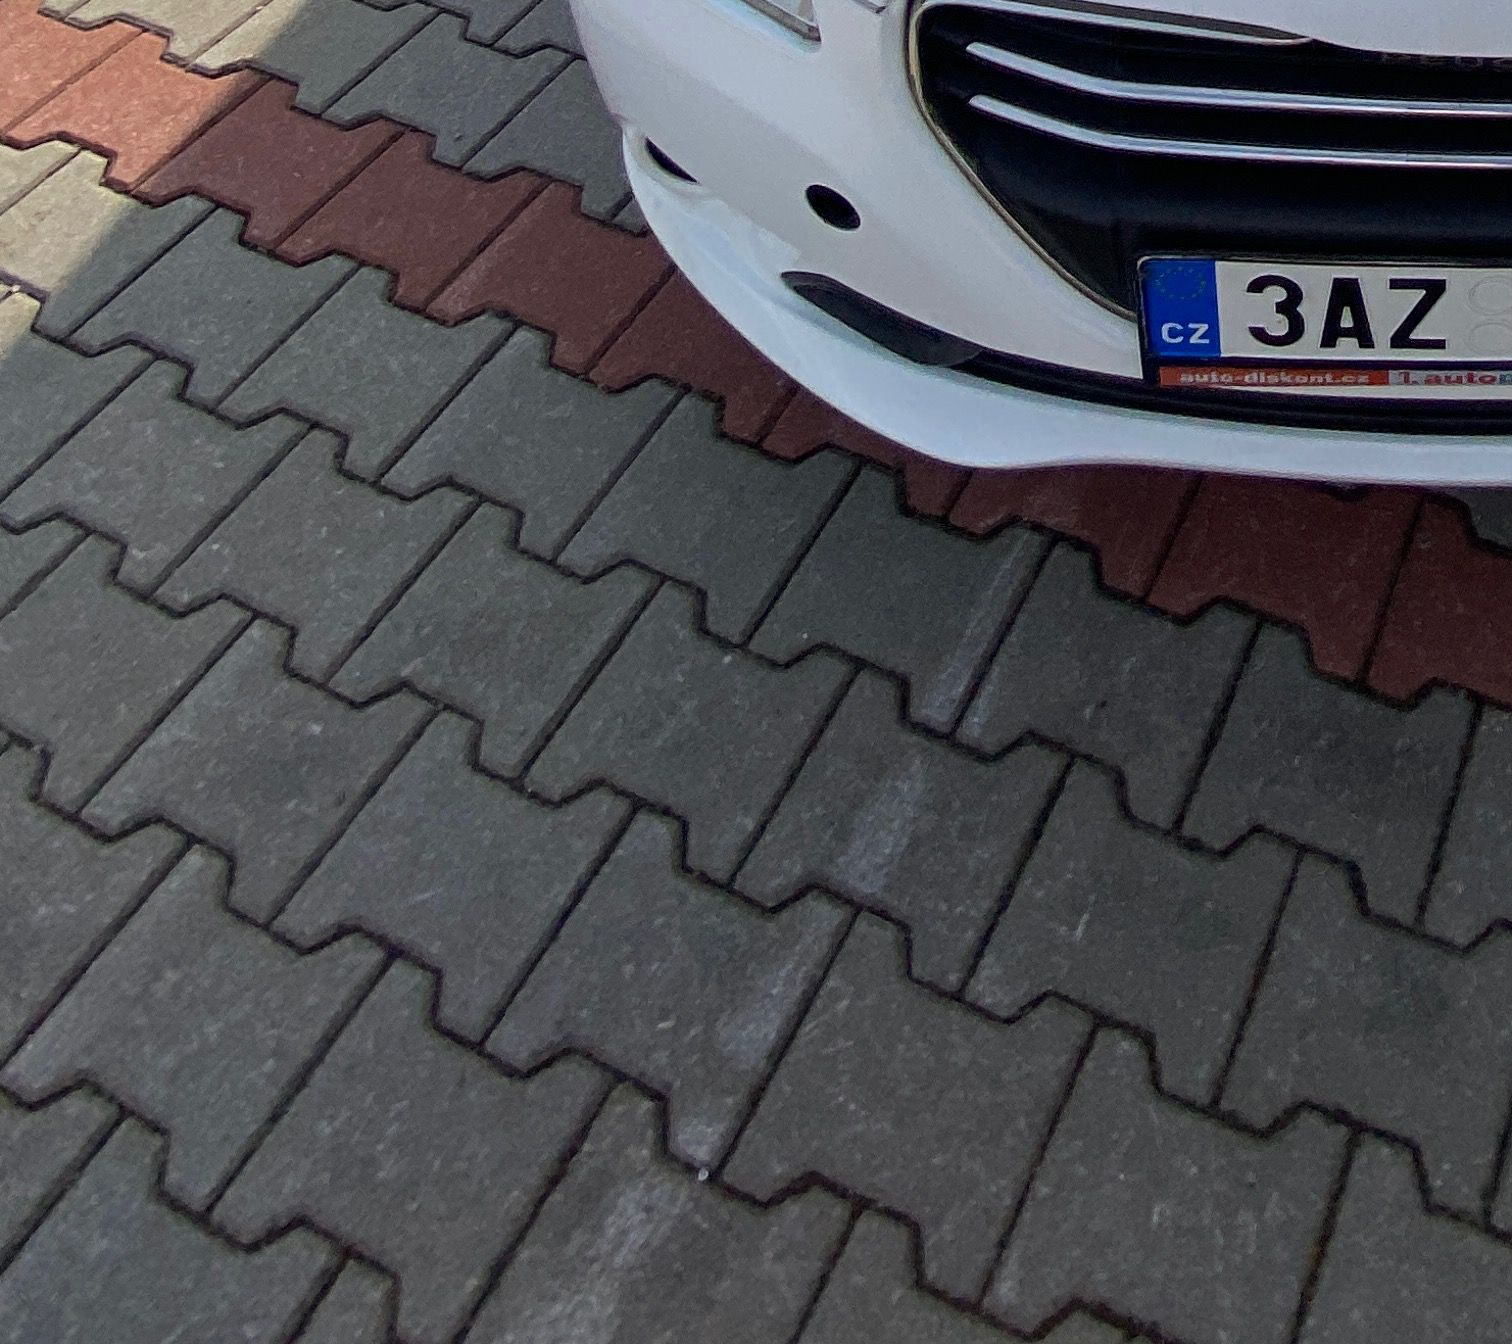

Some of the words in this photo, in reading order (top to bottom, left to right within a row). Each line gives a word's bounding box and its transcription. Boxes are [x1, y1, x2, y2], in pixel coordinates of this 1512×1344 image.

[1246, 273, 1449, 349] 3AZ
[1161, 320, 1211, 344] CZ
[1180, 369, 1370, 385] auto-diskont.cz
